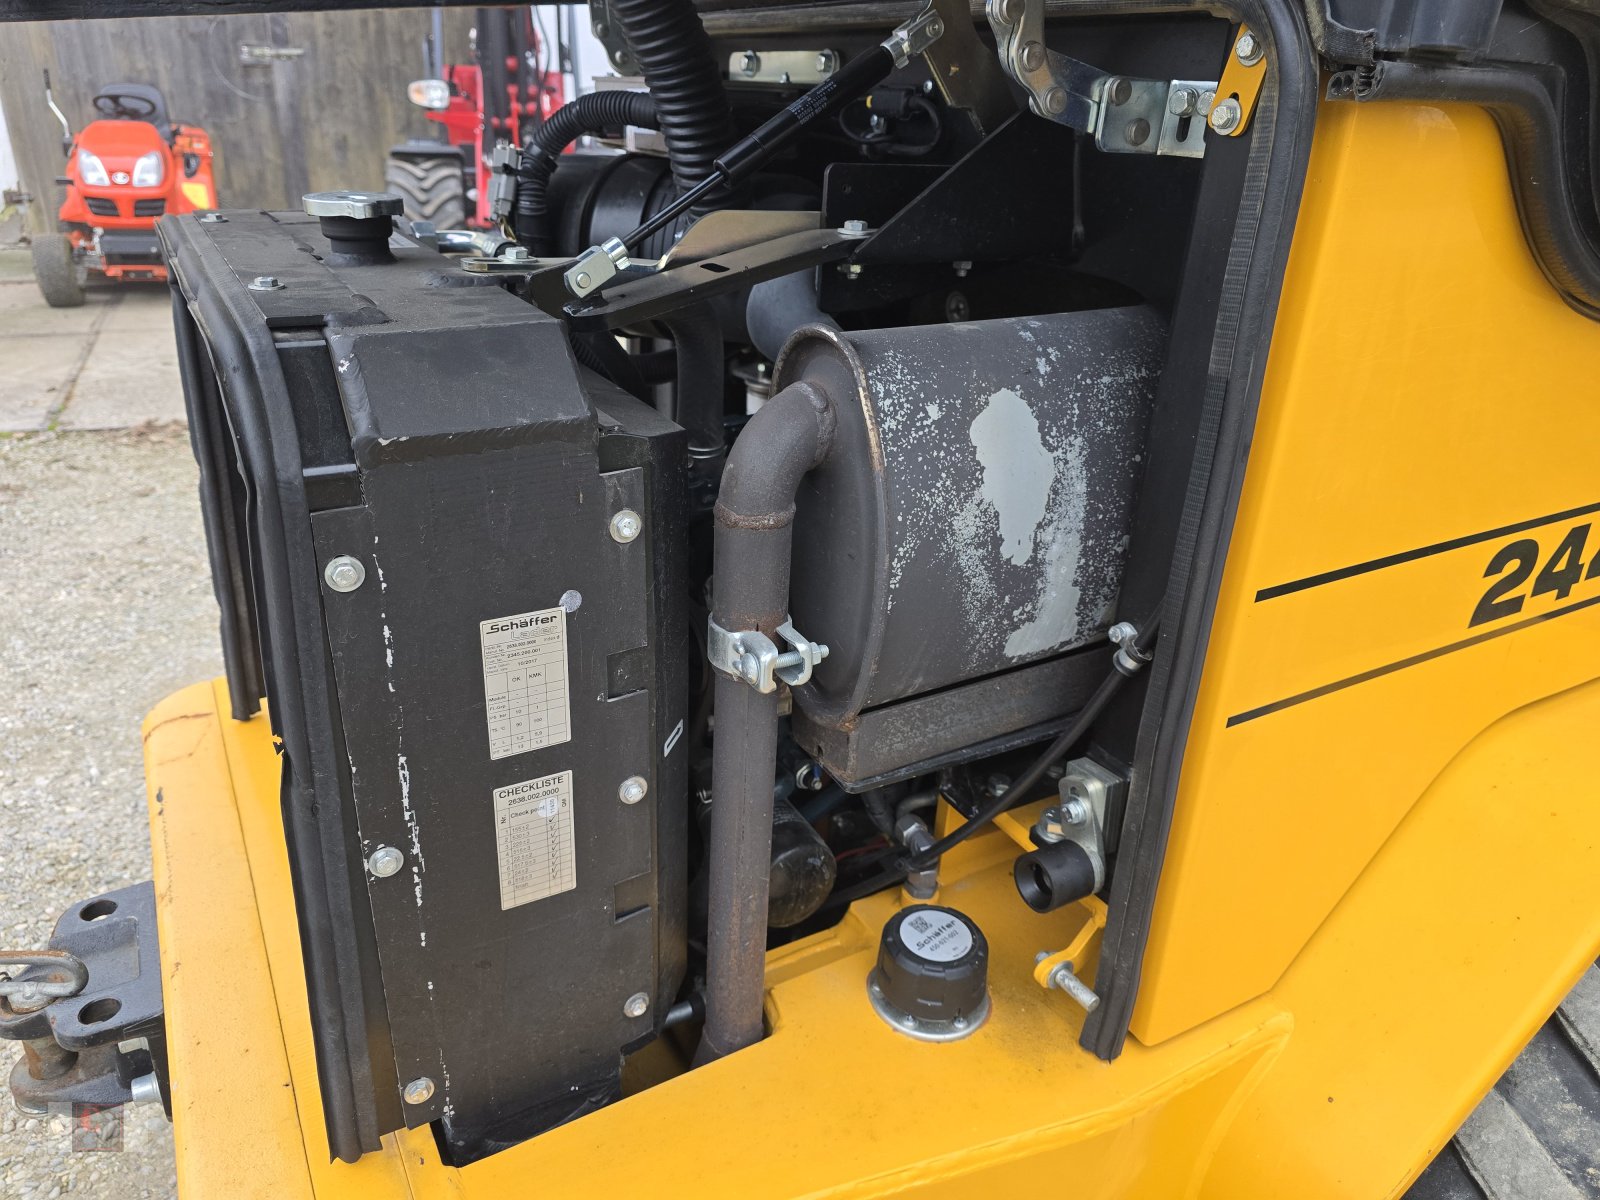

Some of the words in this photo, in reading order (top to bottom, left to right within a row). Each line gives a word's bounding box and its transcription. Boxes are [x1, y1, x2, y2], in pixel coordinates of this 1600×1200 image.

[1467, 522, 1600, 629] 24
[486, 615, 557, 635] Schäffer
[511, 625, 558, 641] Lader
[499, 775, 564, 799] CHECKLISTE
[508, 787, 560, 806] 2638.002.0000
[511, 810, 529, 818] Check
[916, 920, 956, 951] Schäffer
